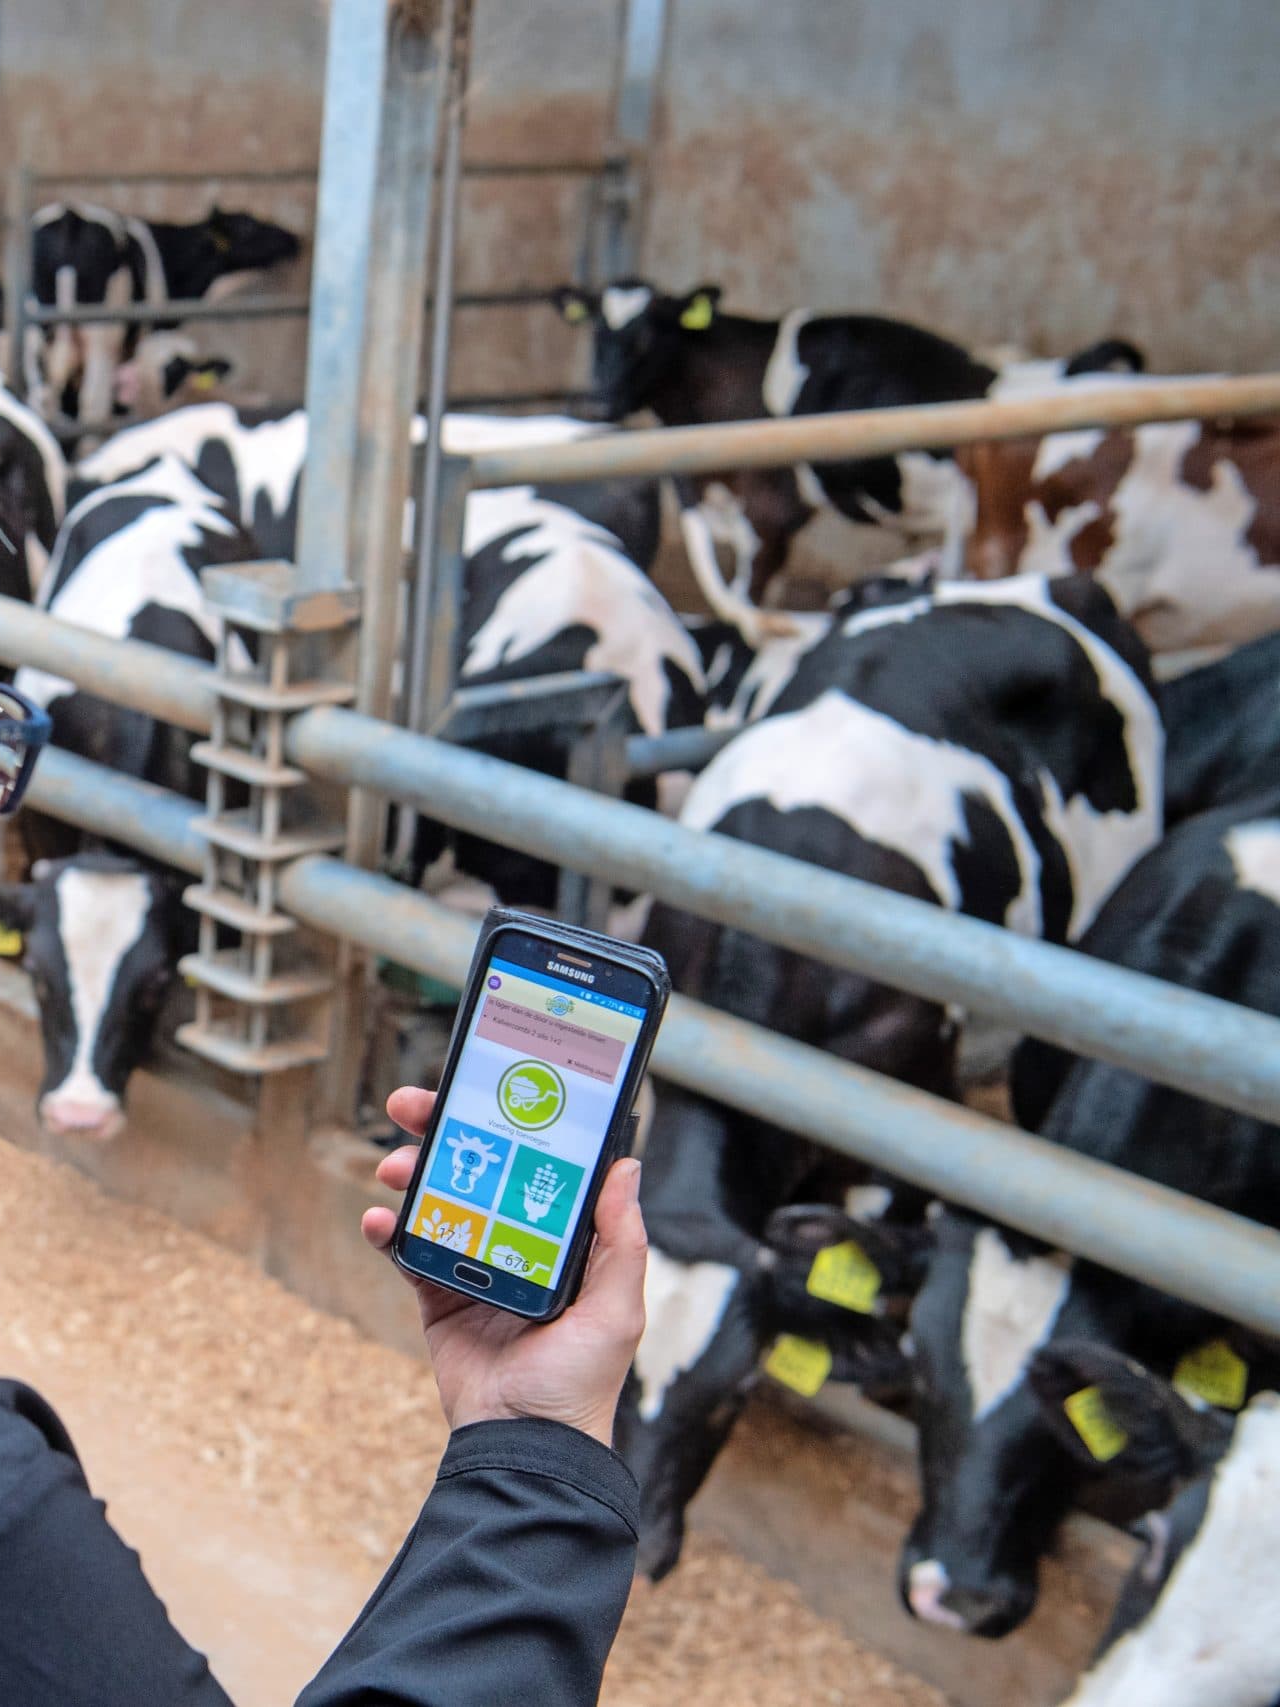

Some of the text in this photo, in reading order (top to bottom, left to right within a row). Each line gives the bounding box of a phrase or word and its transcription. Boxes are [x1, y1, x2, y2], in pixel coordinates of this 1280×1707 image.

[547, 961, 595, 983] SAMSUNG
[488, 1119, 550, 1147] Voeding toevoegen
[466, 1152, 475, 1164] 5
[539, 1179, 547, 1190] 7
[439, 1228, 455, 1242] 17
[505, 1254, 530, 1272] 676
